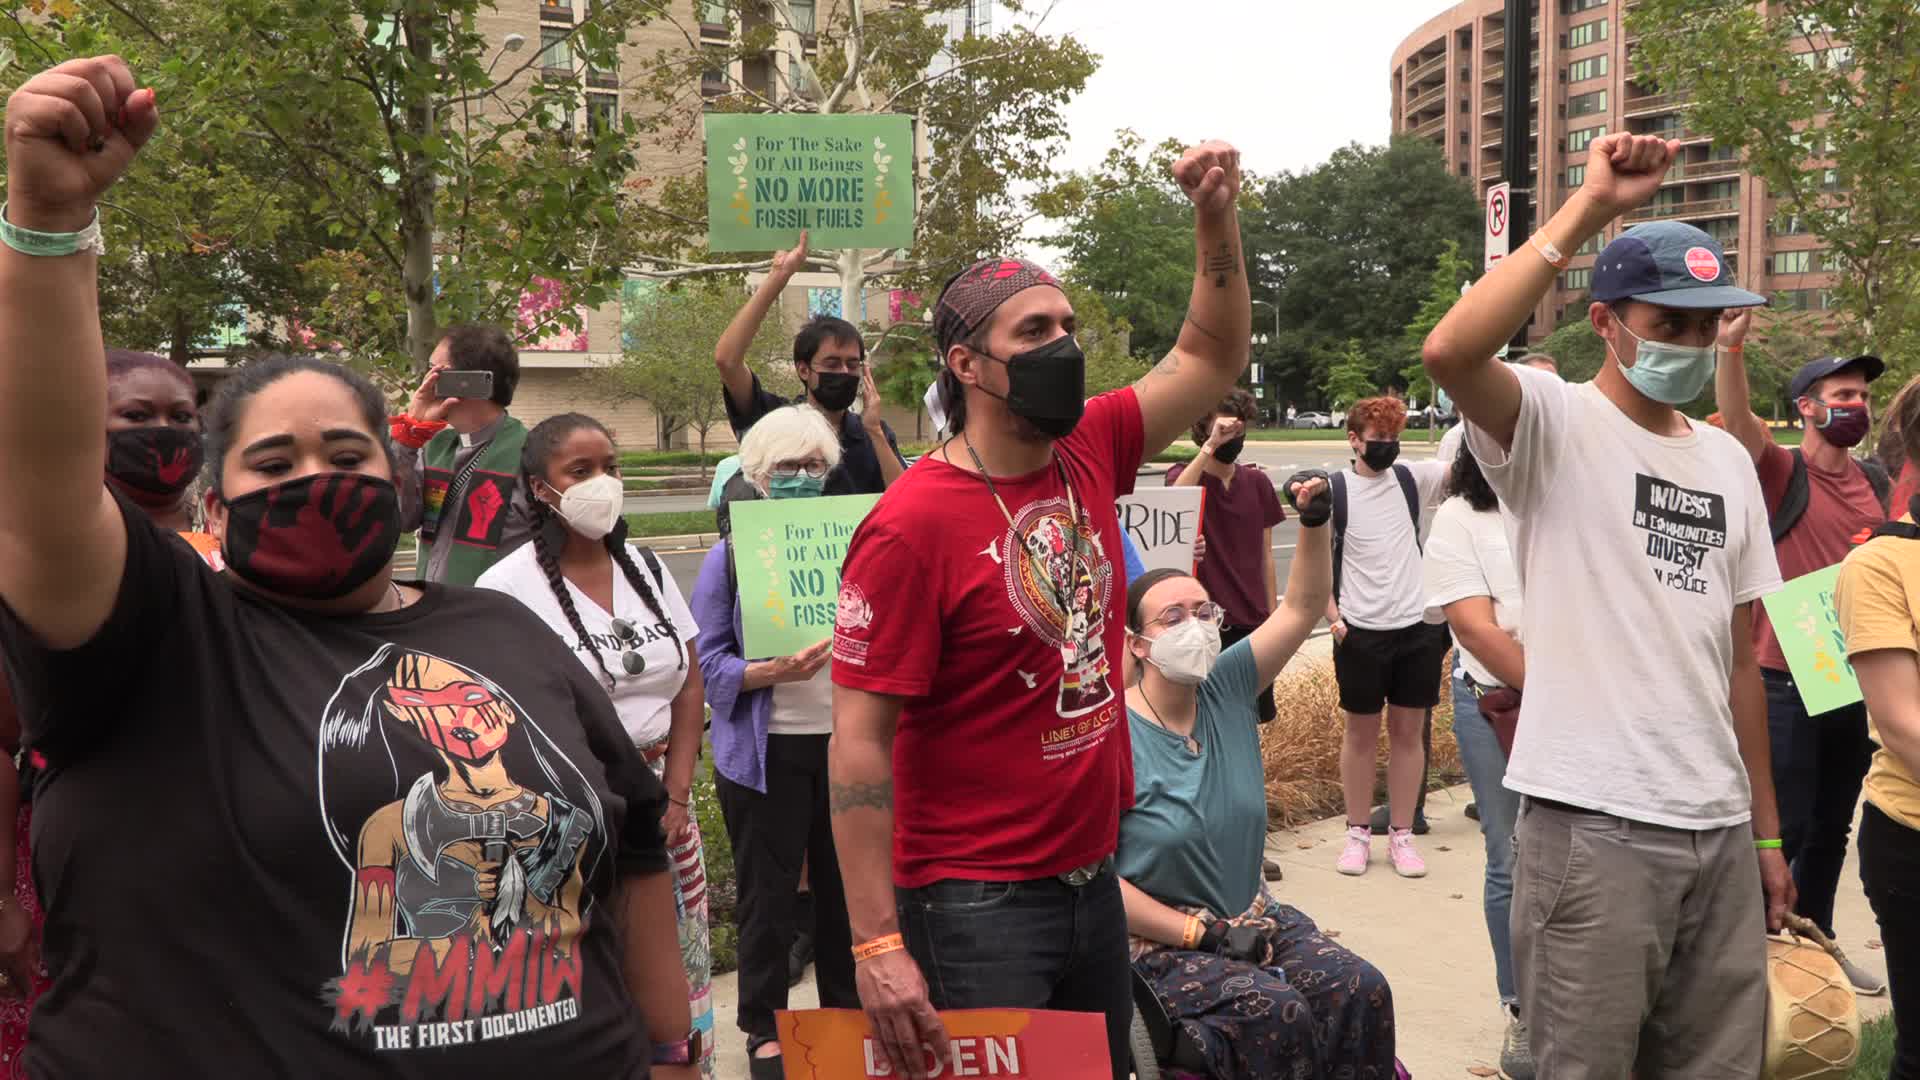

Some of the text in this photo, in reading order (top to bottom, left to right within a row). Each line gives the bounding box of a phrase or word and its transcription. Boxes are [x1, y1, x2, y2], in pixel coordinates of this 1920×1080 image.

[756, 136, 863, 152] For The Sake
[755, 157, 864, 174] Of All Beings
[755, 177, 864, 203] NO MORE
[755, 207, 864, 230] FOSSIL FUELS
[785, 522, 815, 541] For
[1635, 510, 1724, 546] IN COMMUNITIES
[786, 545, 807, 562] Of
[813, 542, 838, 561] All
[789, 567, 825, 599] NO
[1666, 572, 1708, 595] POLICE
[793, 602, 836, 628] FOSS
[560, 634, 622, 652] AND
[1041, 725, 1076, 745] LINES
[374, 998, 577, 1050] THE FIRST DOCUMENTED
[863, 1035, 1020, 1079] BDEN
